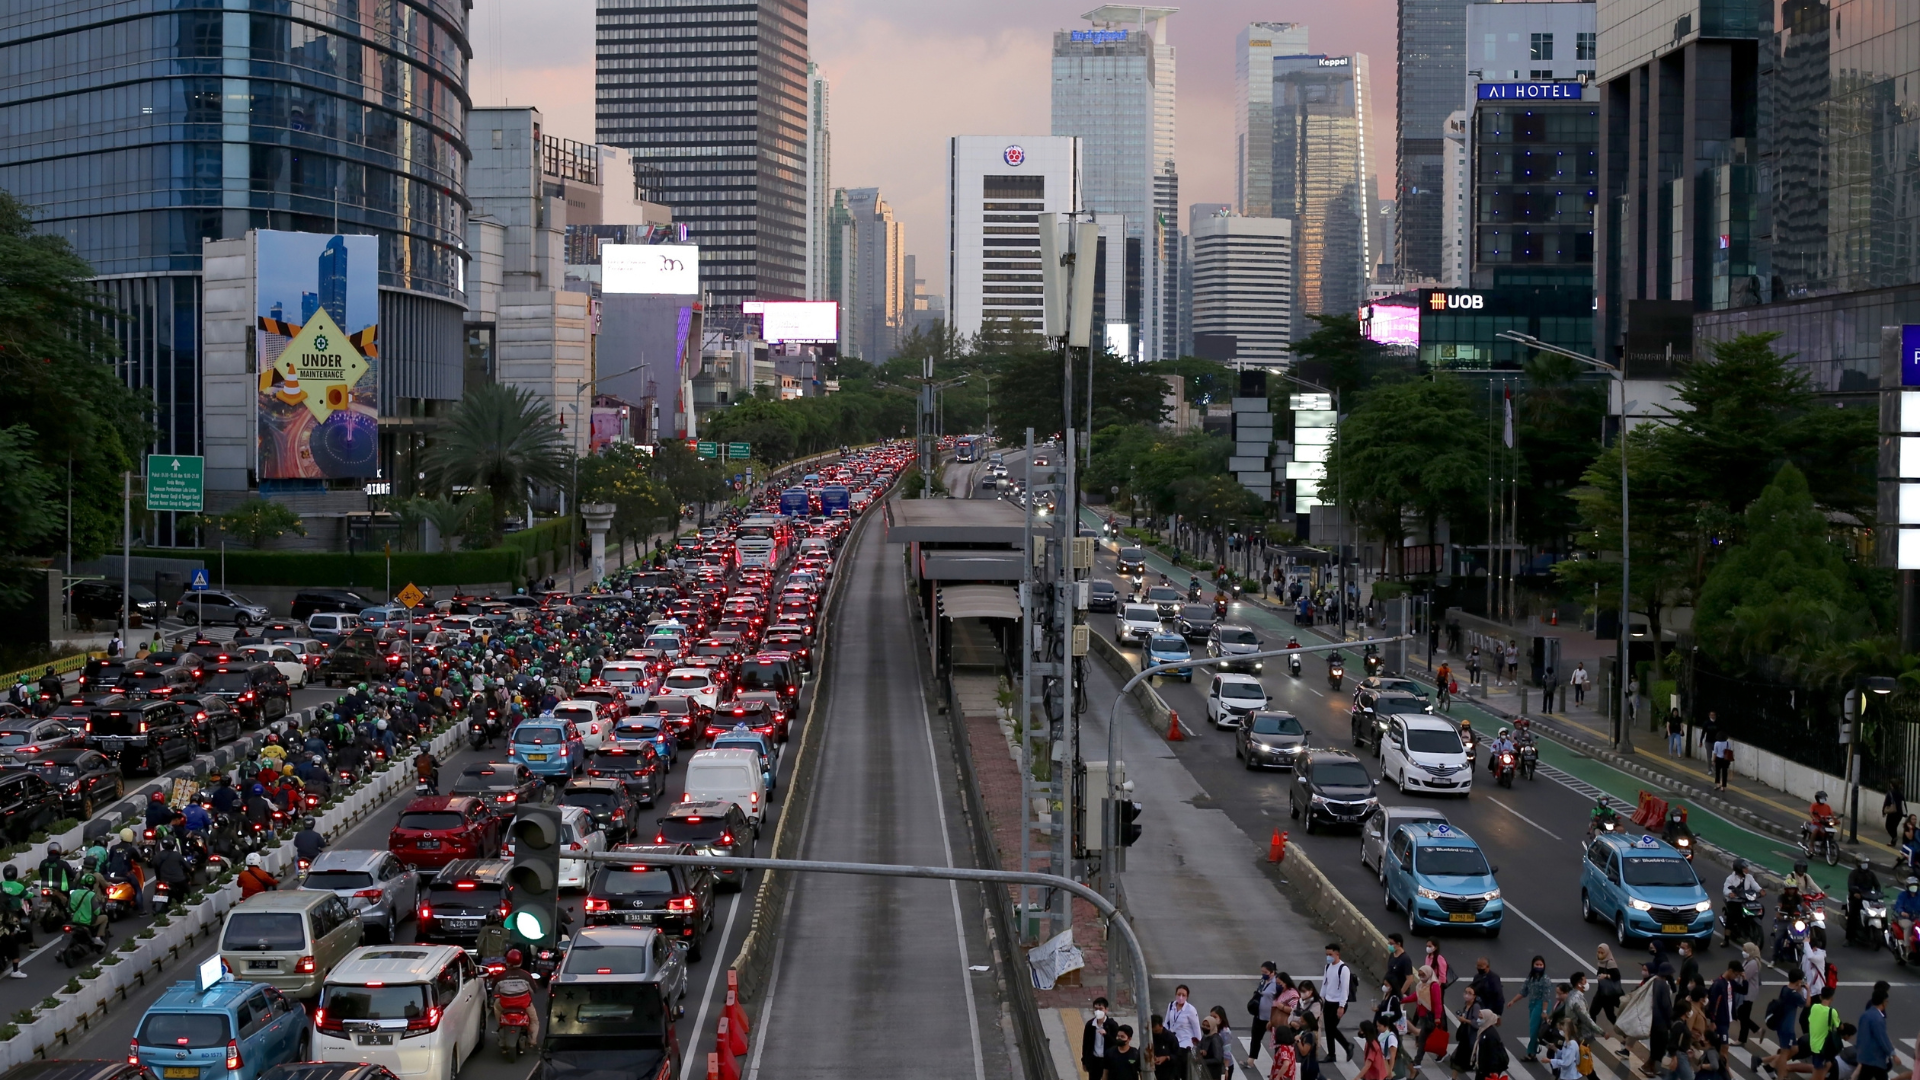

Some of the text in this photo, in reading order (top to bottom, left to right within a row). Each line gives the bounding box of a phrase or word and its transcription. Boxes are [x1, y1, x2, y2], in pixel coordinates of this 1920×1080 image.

[1318, 58, 1348, 67] Keppel
[1516, 85, 1570, 97] HOTEL
[1448, 294, 1484, 309] UOB
[302, 353, 342, 368] UNDER
[1629, 352, 1692, 361] THAMRIN NINE
[299, 370, 344, 379] MAINTENANCE
[586, 988, 624, 1000] TSM
